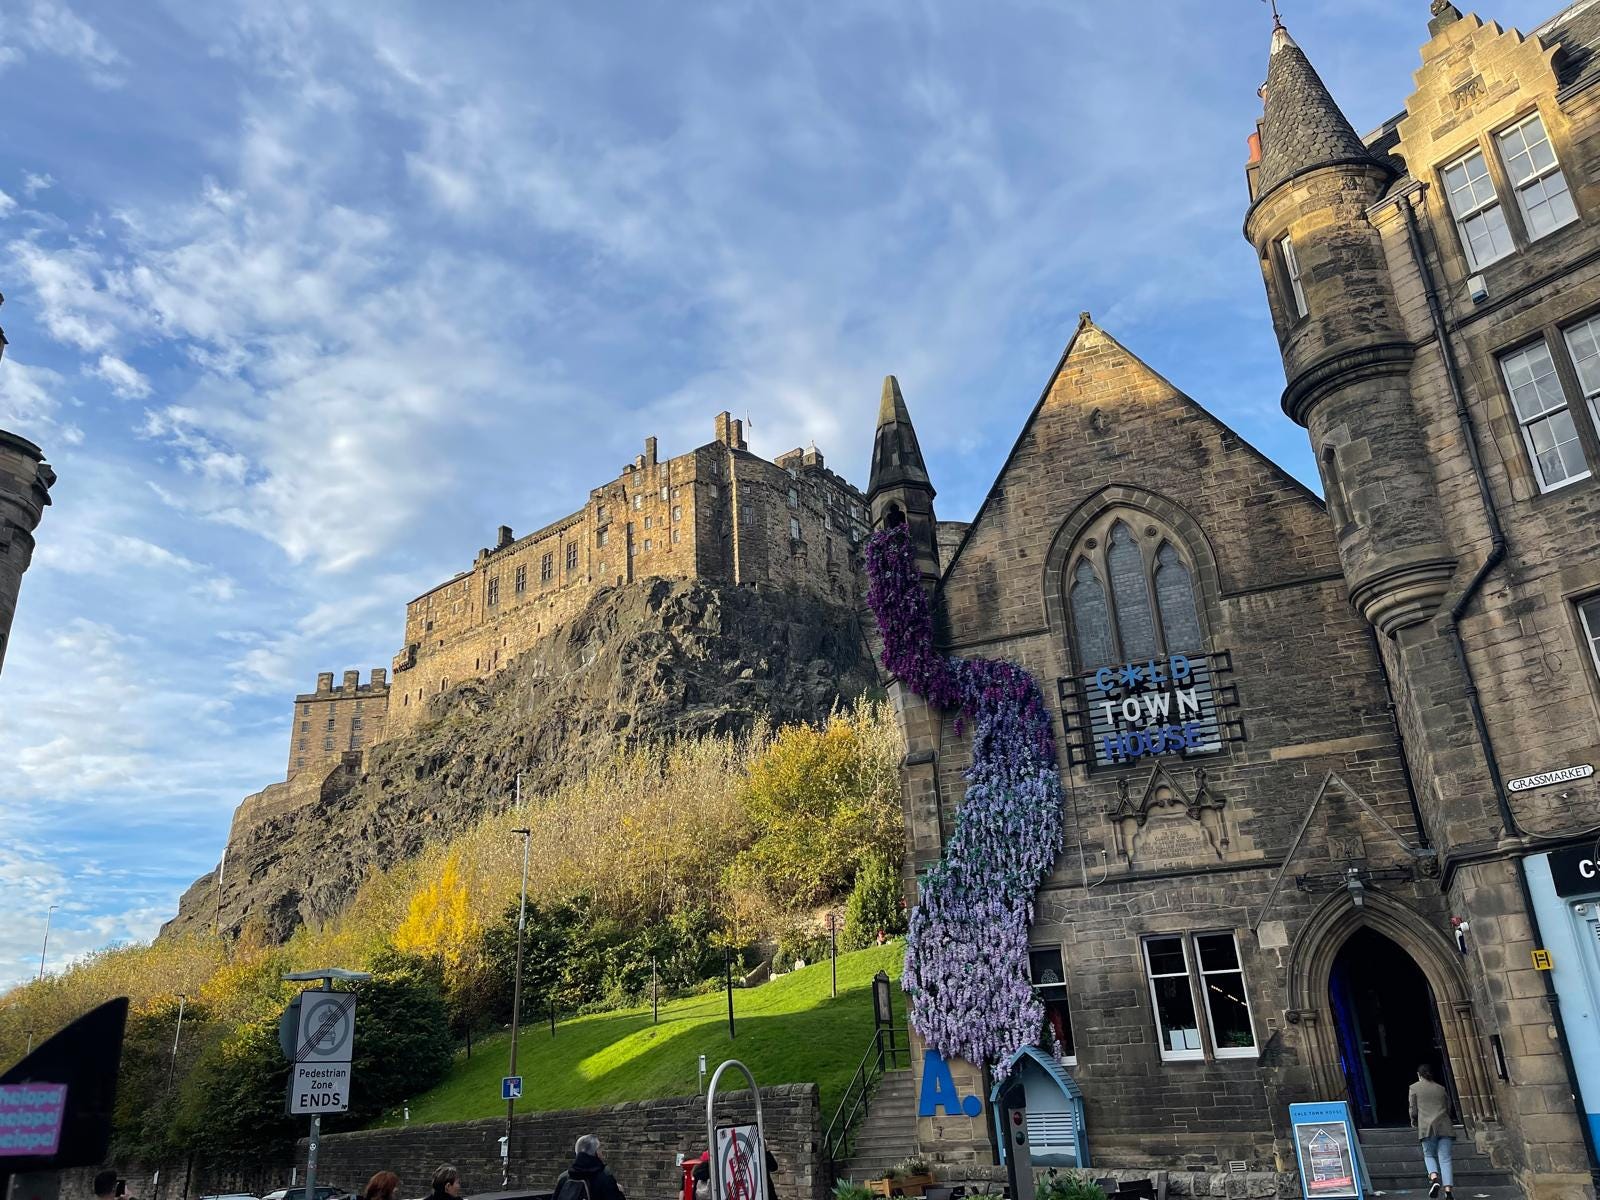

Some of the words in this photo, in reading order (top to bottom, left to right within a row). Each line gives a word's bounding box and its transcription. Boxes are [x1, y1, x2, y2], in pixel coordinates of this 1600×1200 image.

[1099, 687, 1199, 725] TOWN
[1104, 722, 1204, 760] HOUSE
[1512, 766, 1588, 789] GRASSMARKET
[300, 1069, 346, 1078] Pedestrian
[311, 1080, 333, 1089] Zone
[300, 1093, 341, 1107] ENDS
